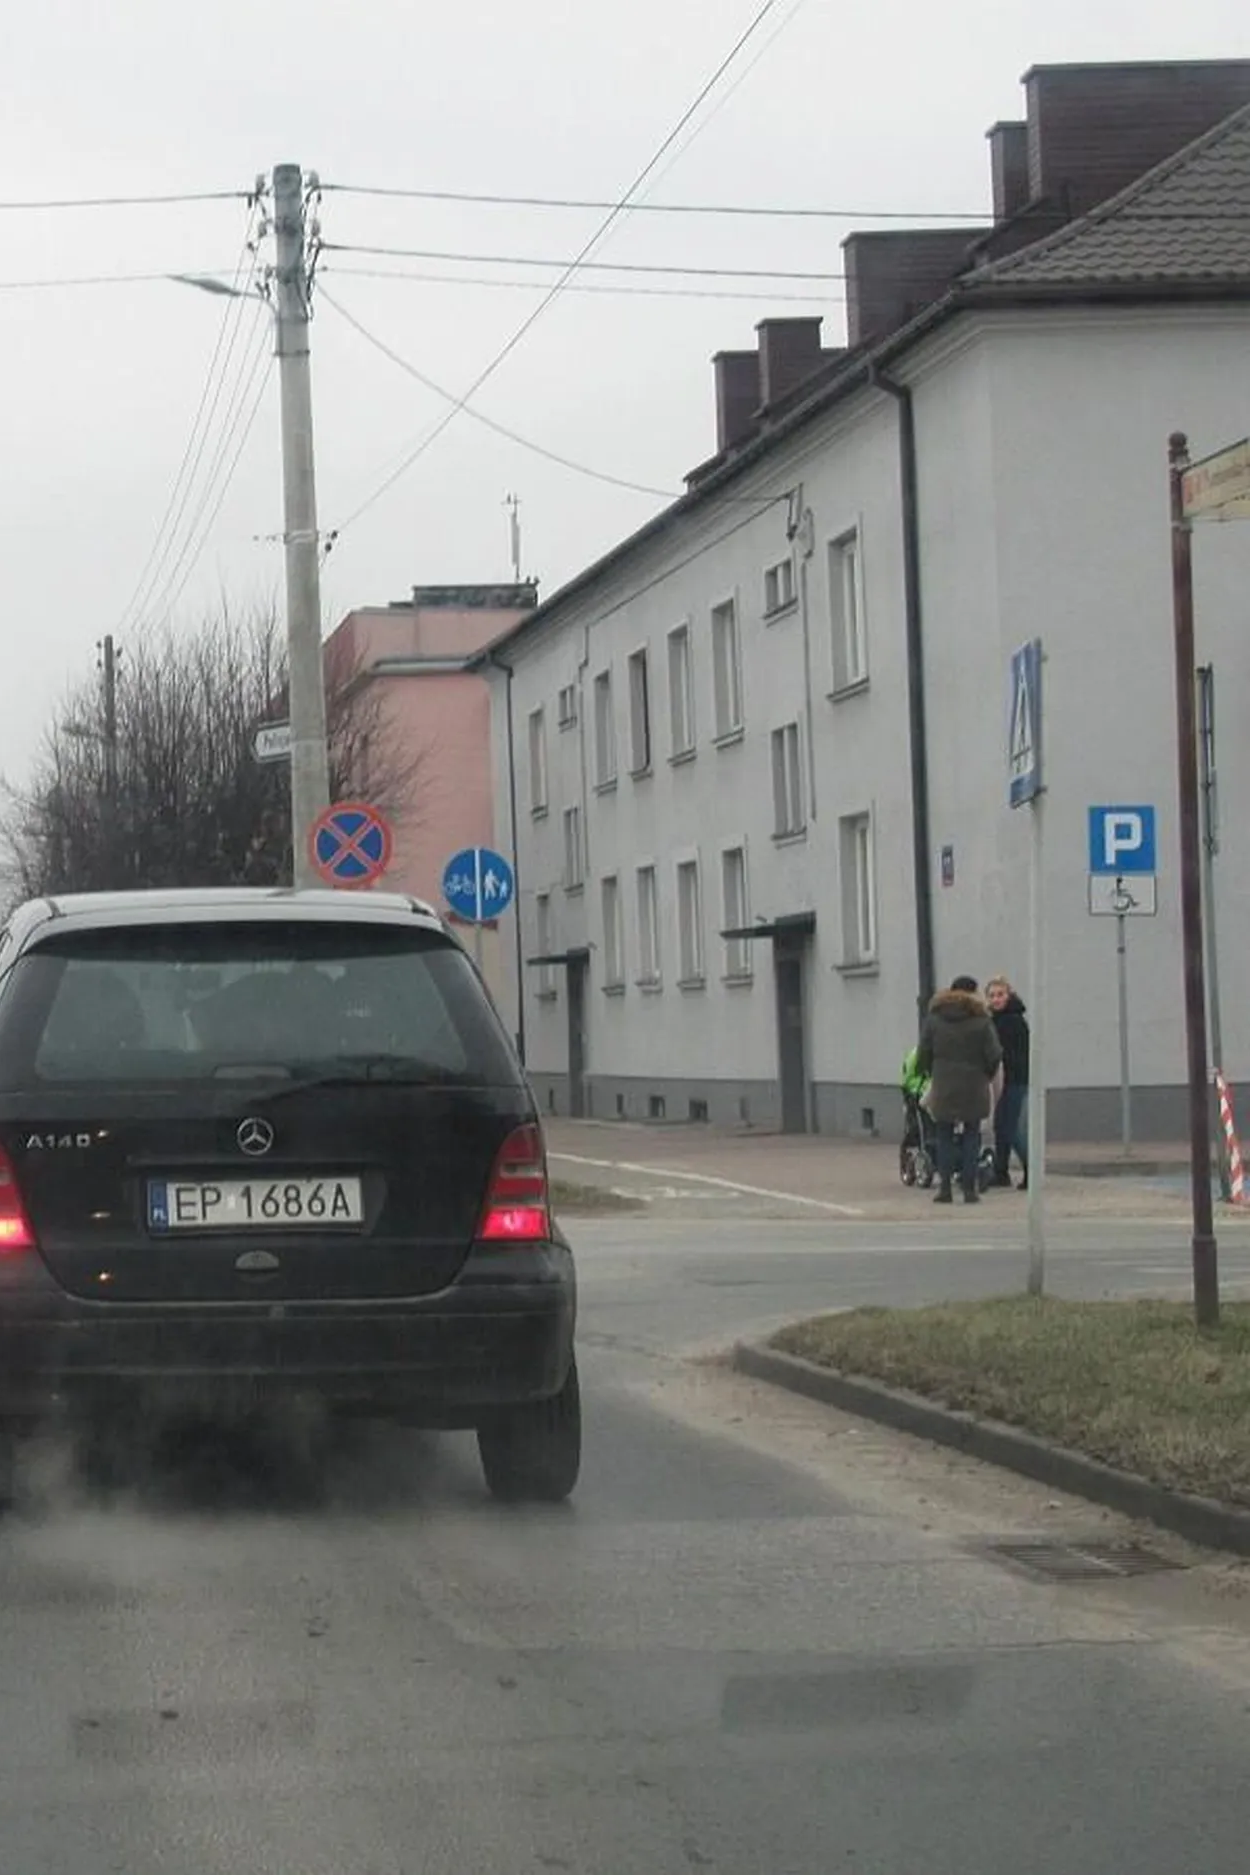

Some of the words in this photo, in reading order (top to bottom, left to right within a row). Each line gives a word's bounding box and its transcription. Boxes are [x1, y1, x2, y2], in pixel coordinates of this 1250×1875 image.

[1104, 813, 1142, 865] P
[174, 1185, 222, 1222] EP
[239, 1182, 351, 1219] 1686A
